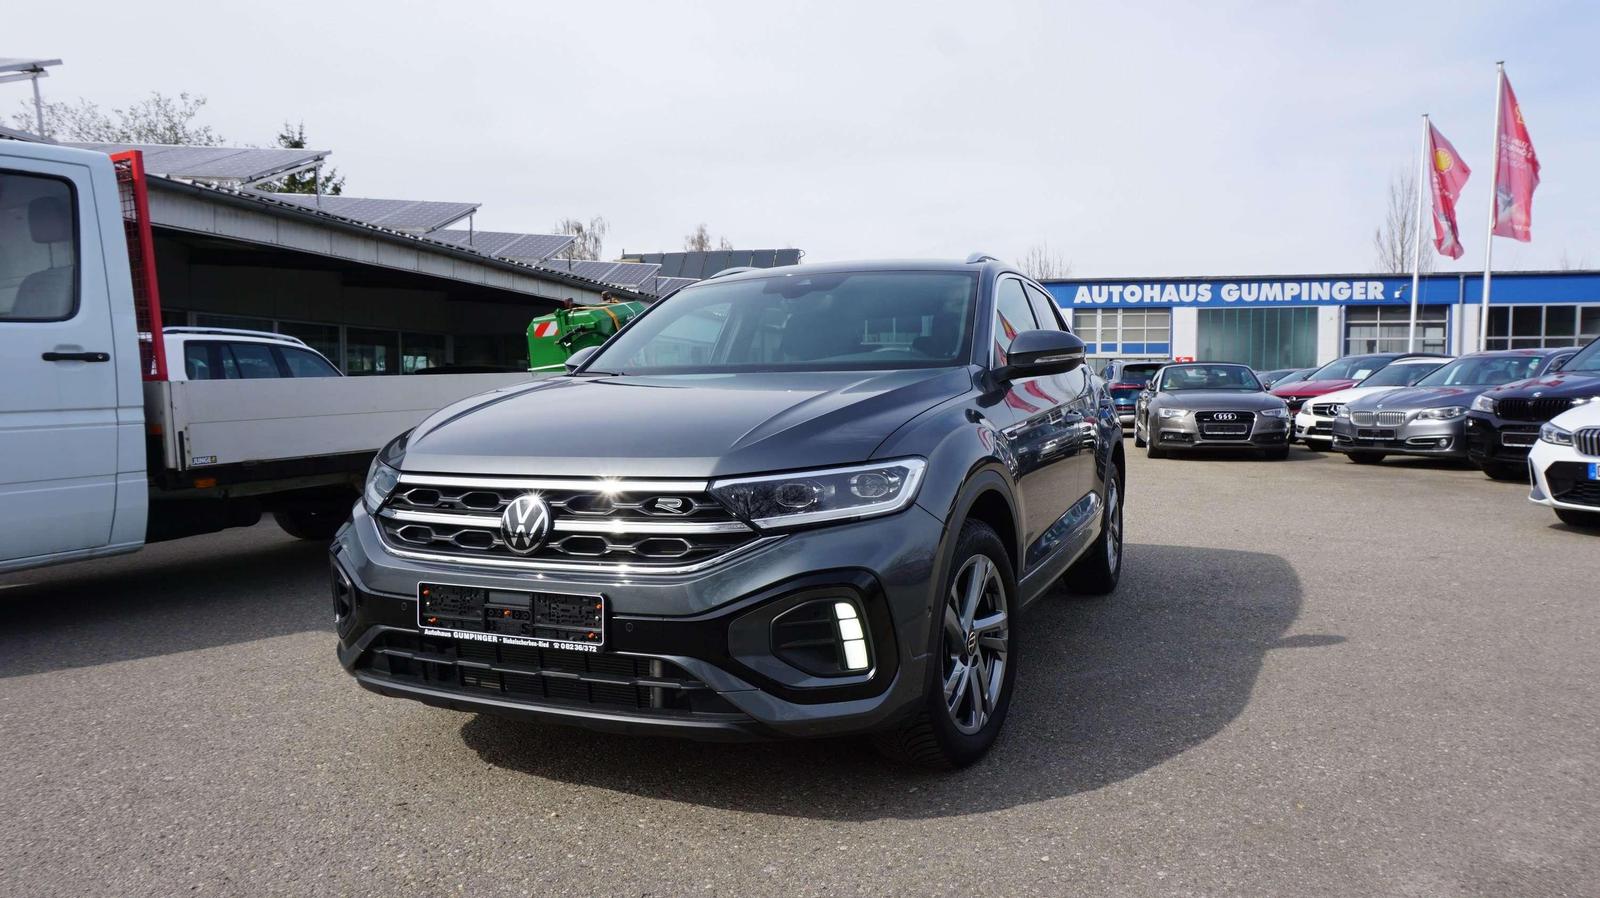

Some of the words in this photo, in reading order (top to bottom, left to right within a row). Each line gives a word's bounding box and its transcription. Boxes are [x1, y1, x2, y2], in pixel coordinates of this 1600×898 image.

[1073, 284, 1212, 304] AUTOHAUS
[1221, 281, 1385, 302] GUMPINGER
[424, 628, 452, 638] Autohaus
[453, 631, 498, 643] GUMPINGER
